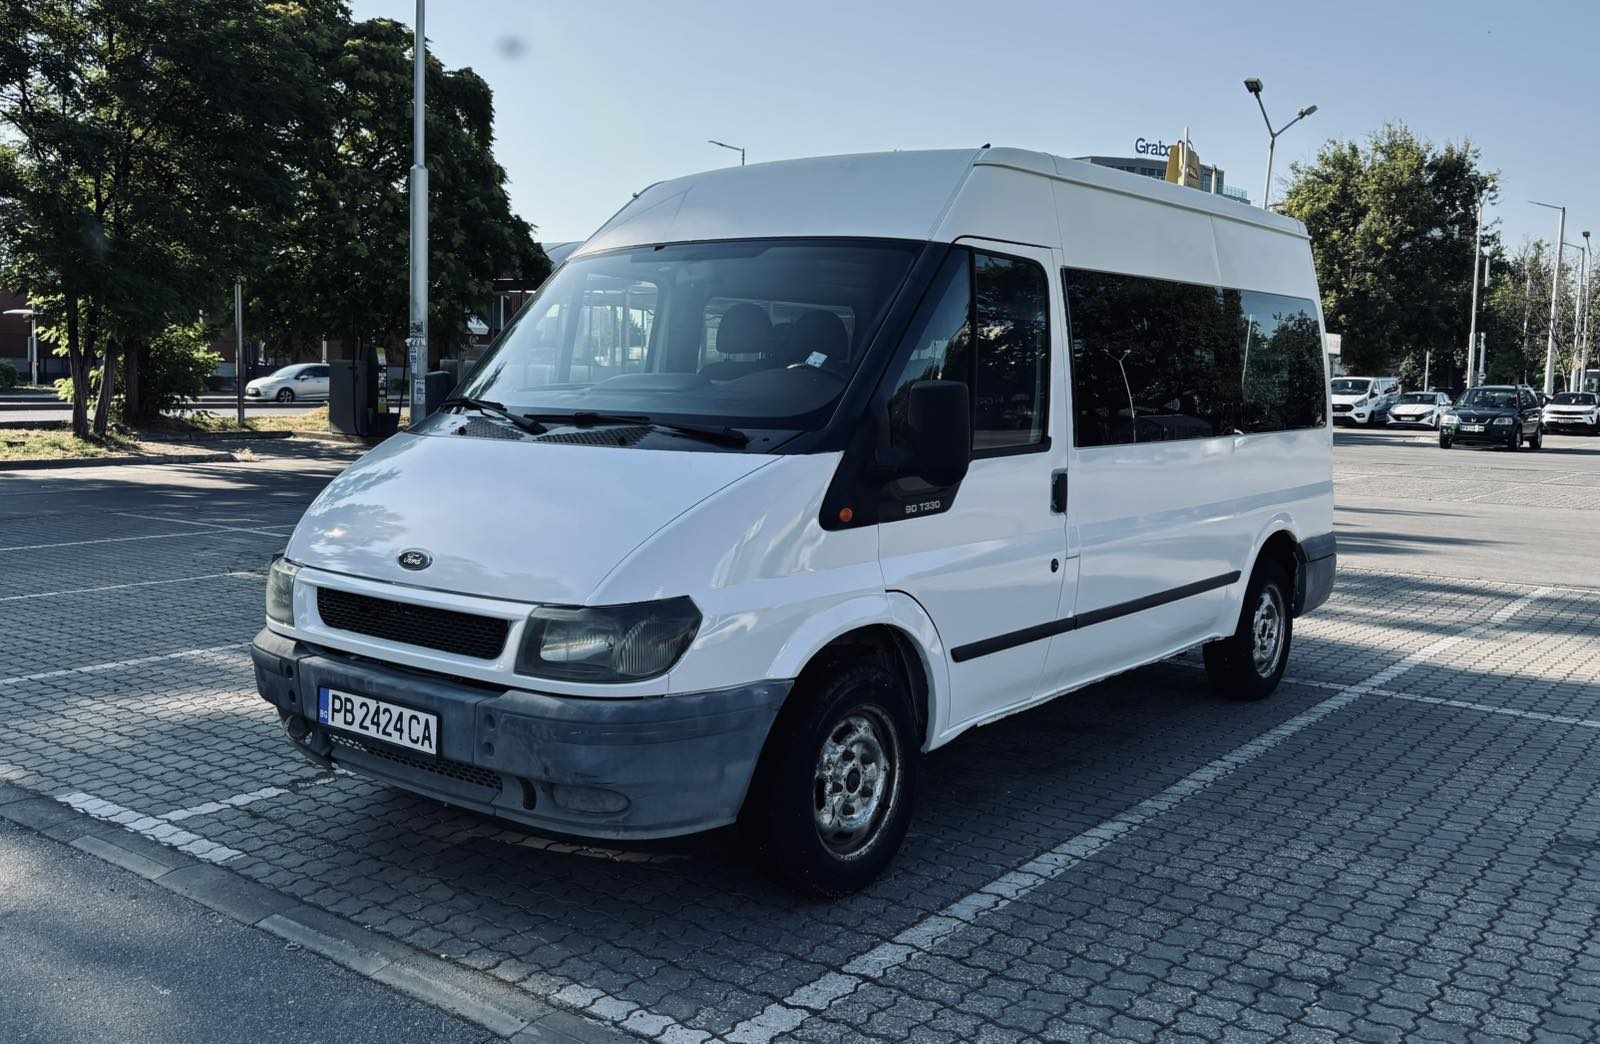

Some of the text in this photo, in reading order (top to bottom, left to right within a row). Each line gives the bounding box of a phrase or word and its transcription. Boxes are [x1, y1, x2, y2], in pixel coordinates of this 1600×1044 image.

[905, 500, 941, 514] 90 T330
[403, 553, 423, 565] Ford
